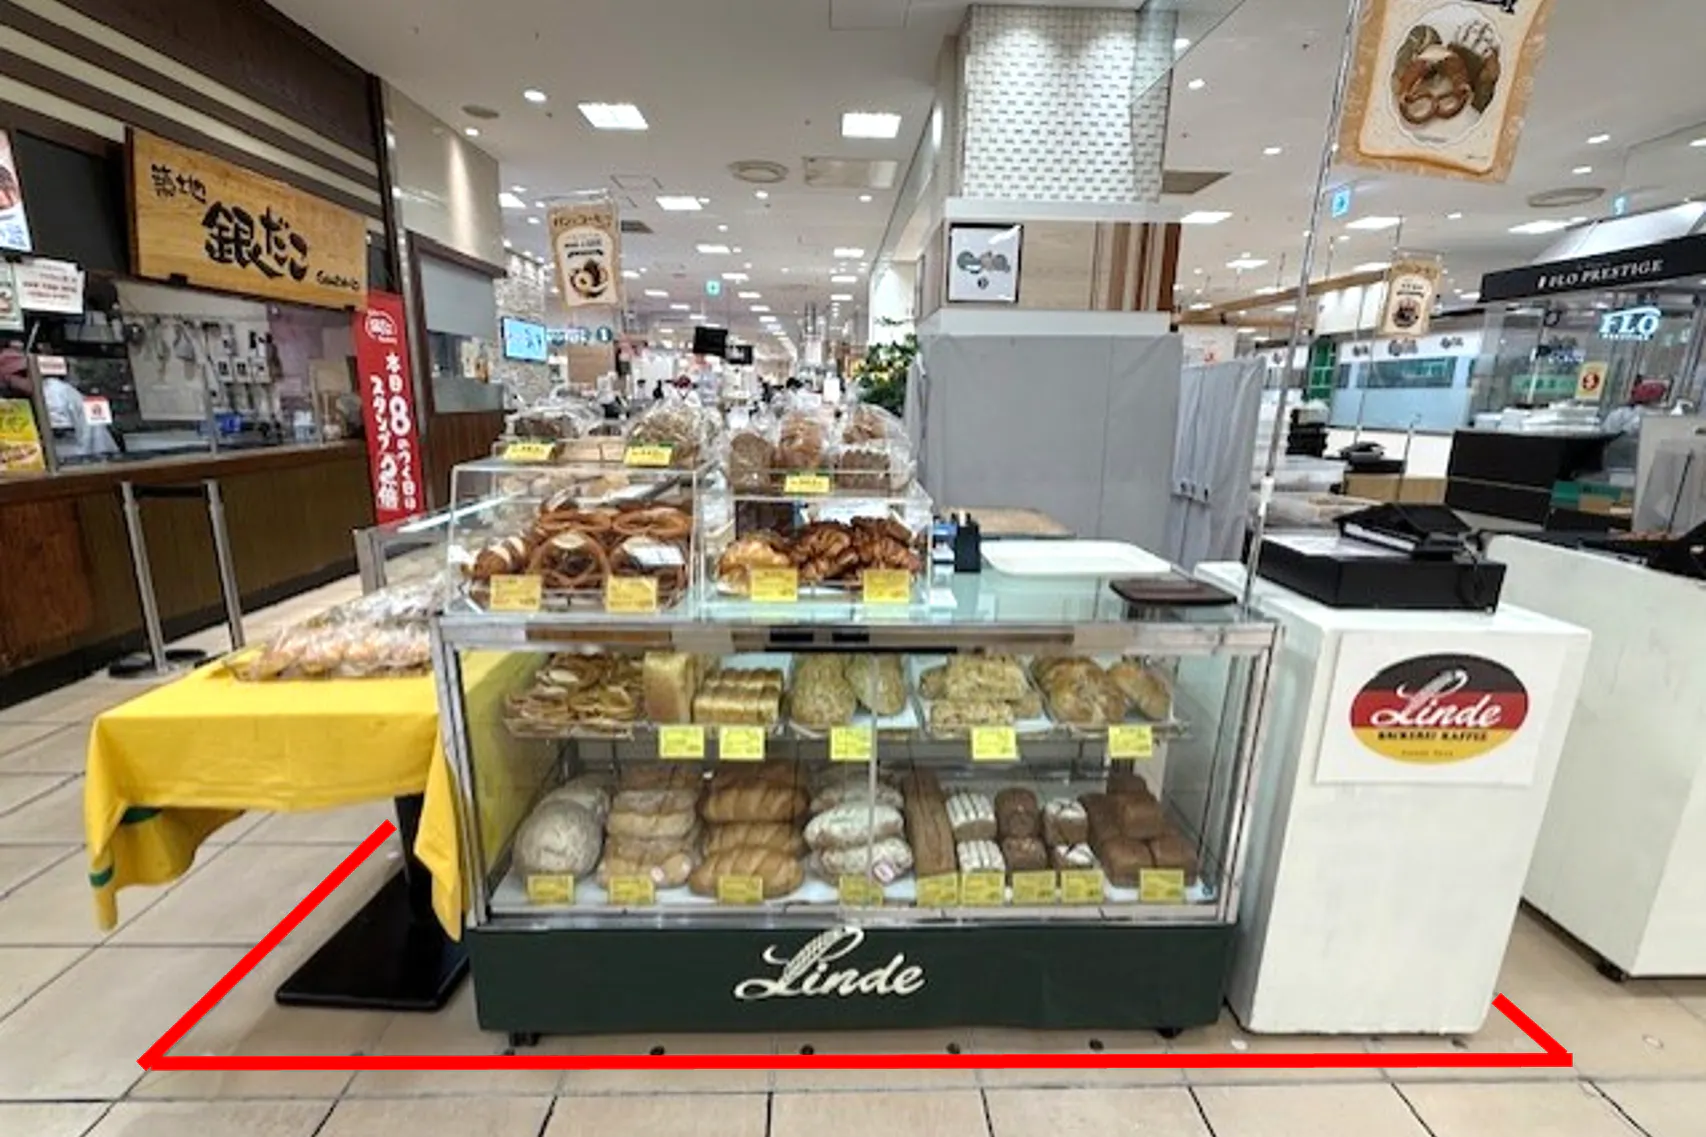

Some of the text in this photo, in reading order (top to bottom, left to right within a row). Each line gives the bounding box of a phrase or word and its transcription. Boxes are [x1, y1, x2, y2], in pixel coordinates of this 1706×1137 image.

[152, 164, 206, 204] 築地
[202, 201, 308, 281] 銀だこ
[1581, 259, 1664, 283] PRESTIGE
[1599, 307, 1661, 337] FLO
[1369, 669, 1502, 728] Linde
[733, 925, 926, 1000] Linde
